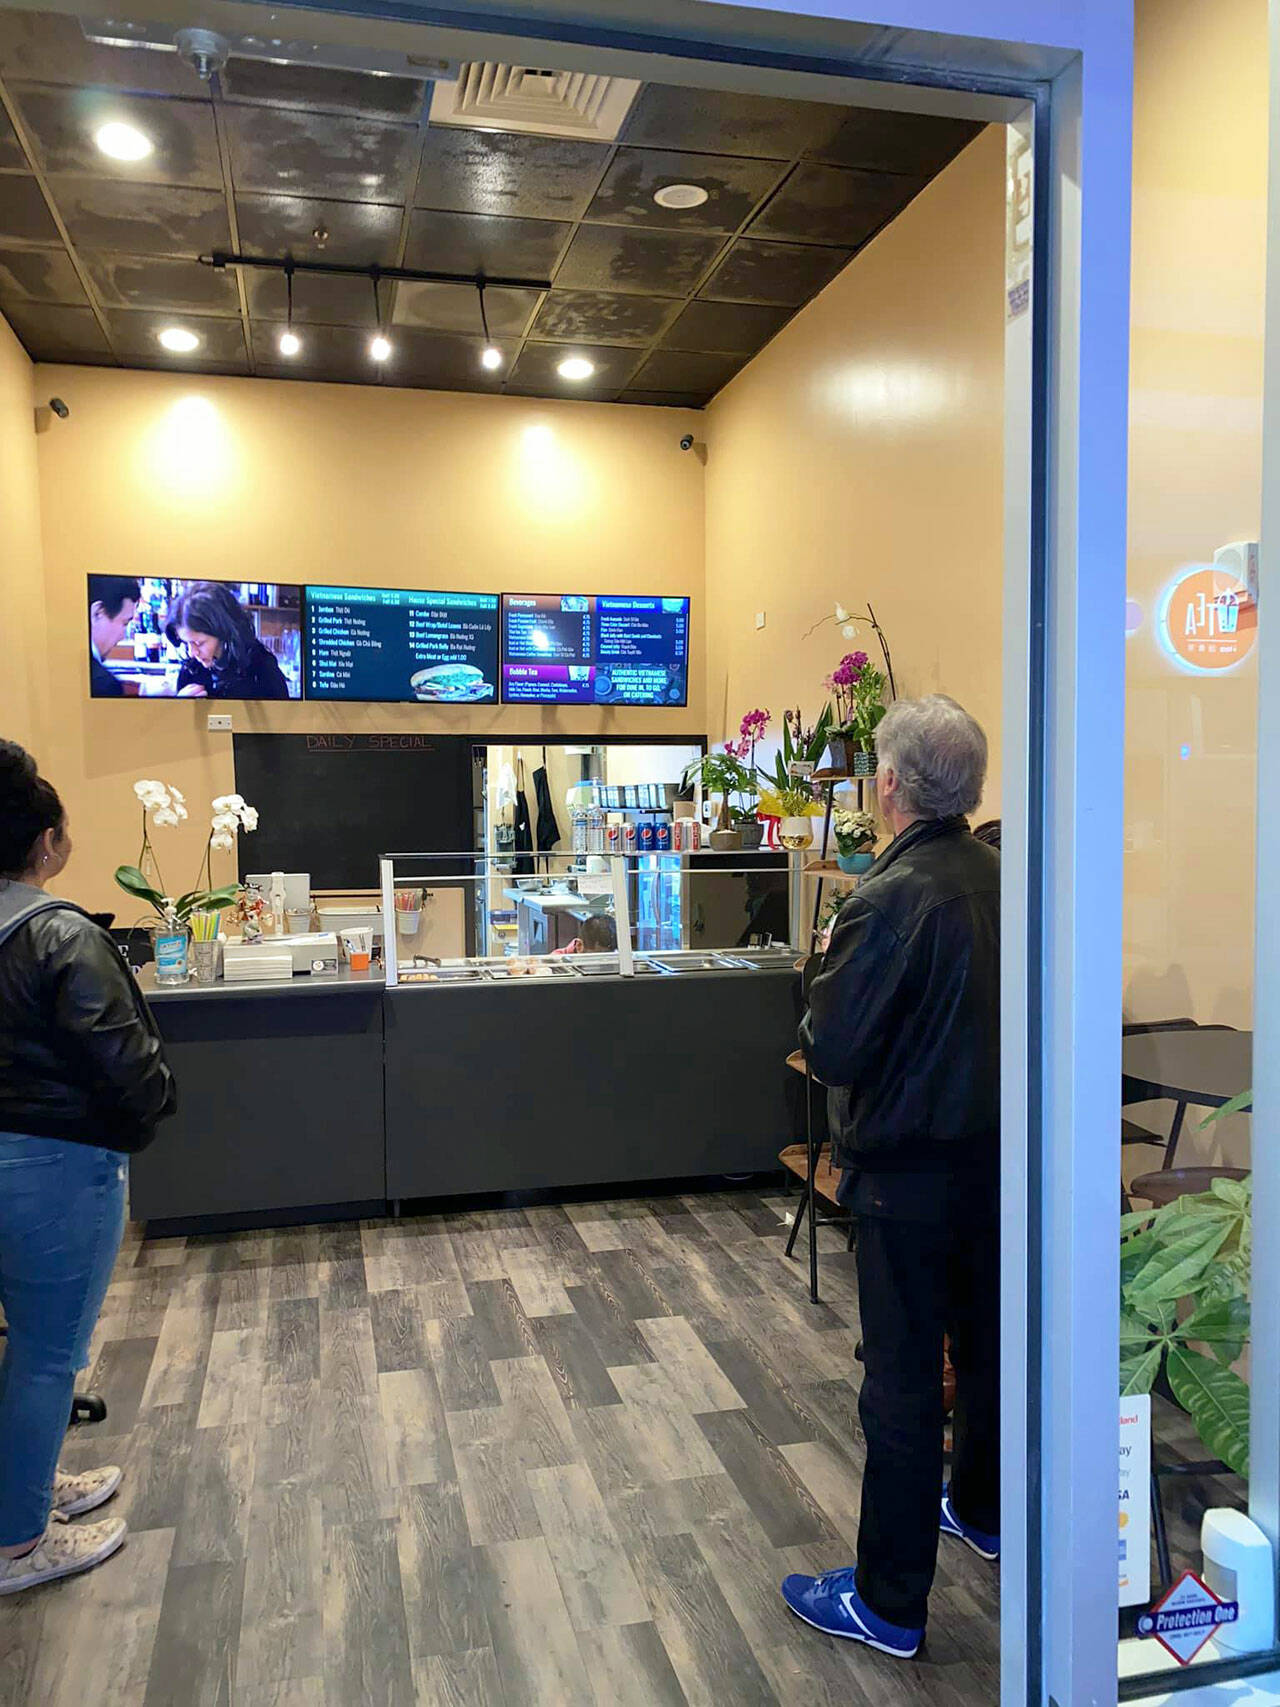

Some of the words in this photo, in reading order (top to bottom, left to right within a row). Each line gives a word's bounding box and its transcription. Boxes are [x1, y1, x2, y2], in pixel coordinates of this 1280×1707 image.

[311, 592, 343, 600] Vietnamese
[344, 592, 376, 602] Sandwiches
[447, 598, 477, 606] Sandwiches
[602, 600, 631, 608] Vietnamese
[528, 668, 538, 676] Tea
[306, 735, 356, 748] DAILY
[369, 736, 432, 748] SPECIAL
[1156, 1609, 1213, 1630] Protection
[1214, 1606, 1235, 1622] One
